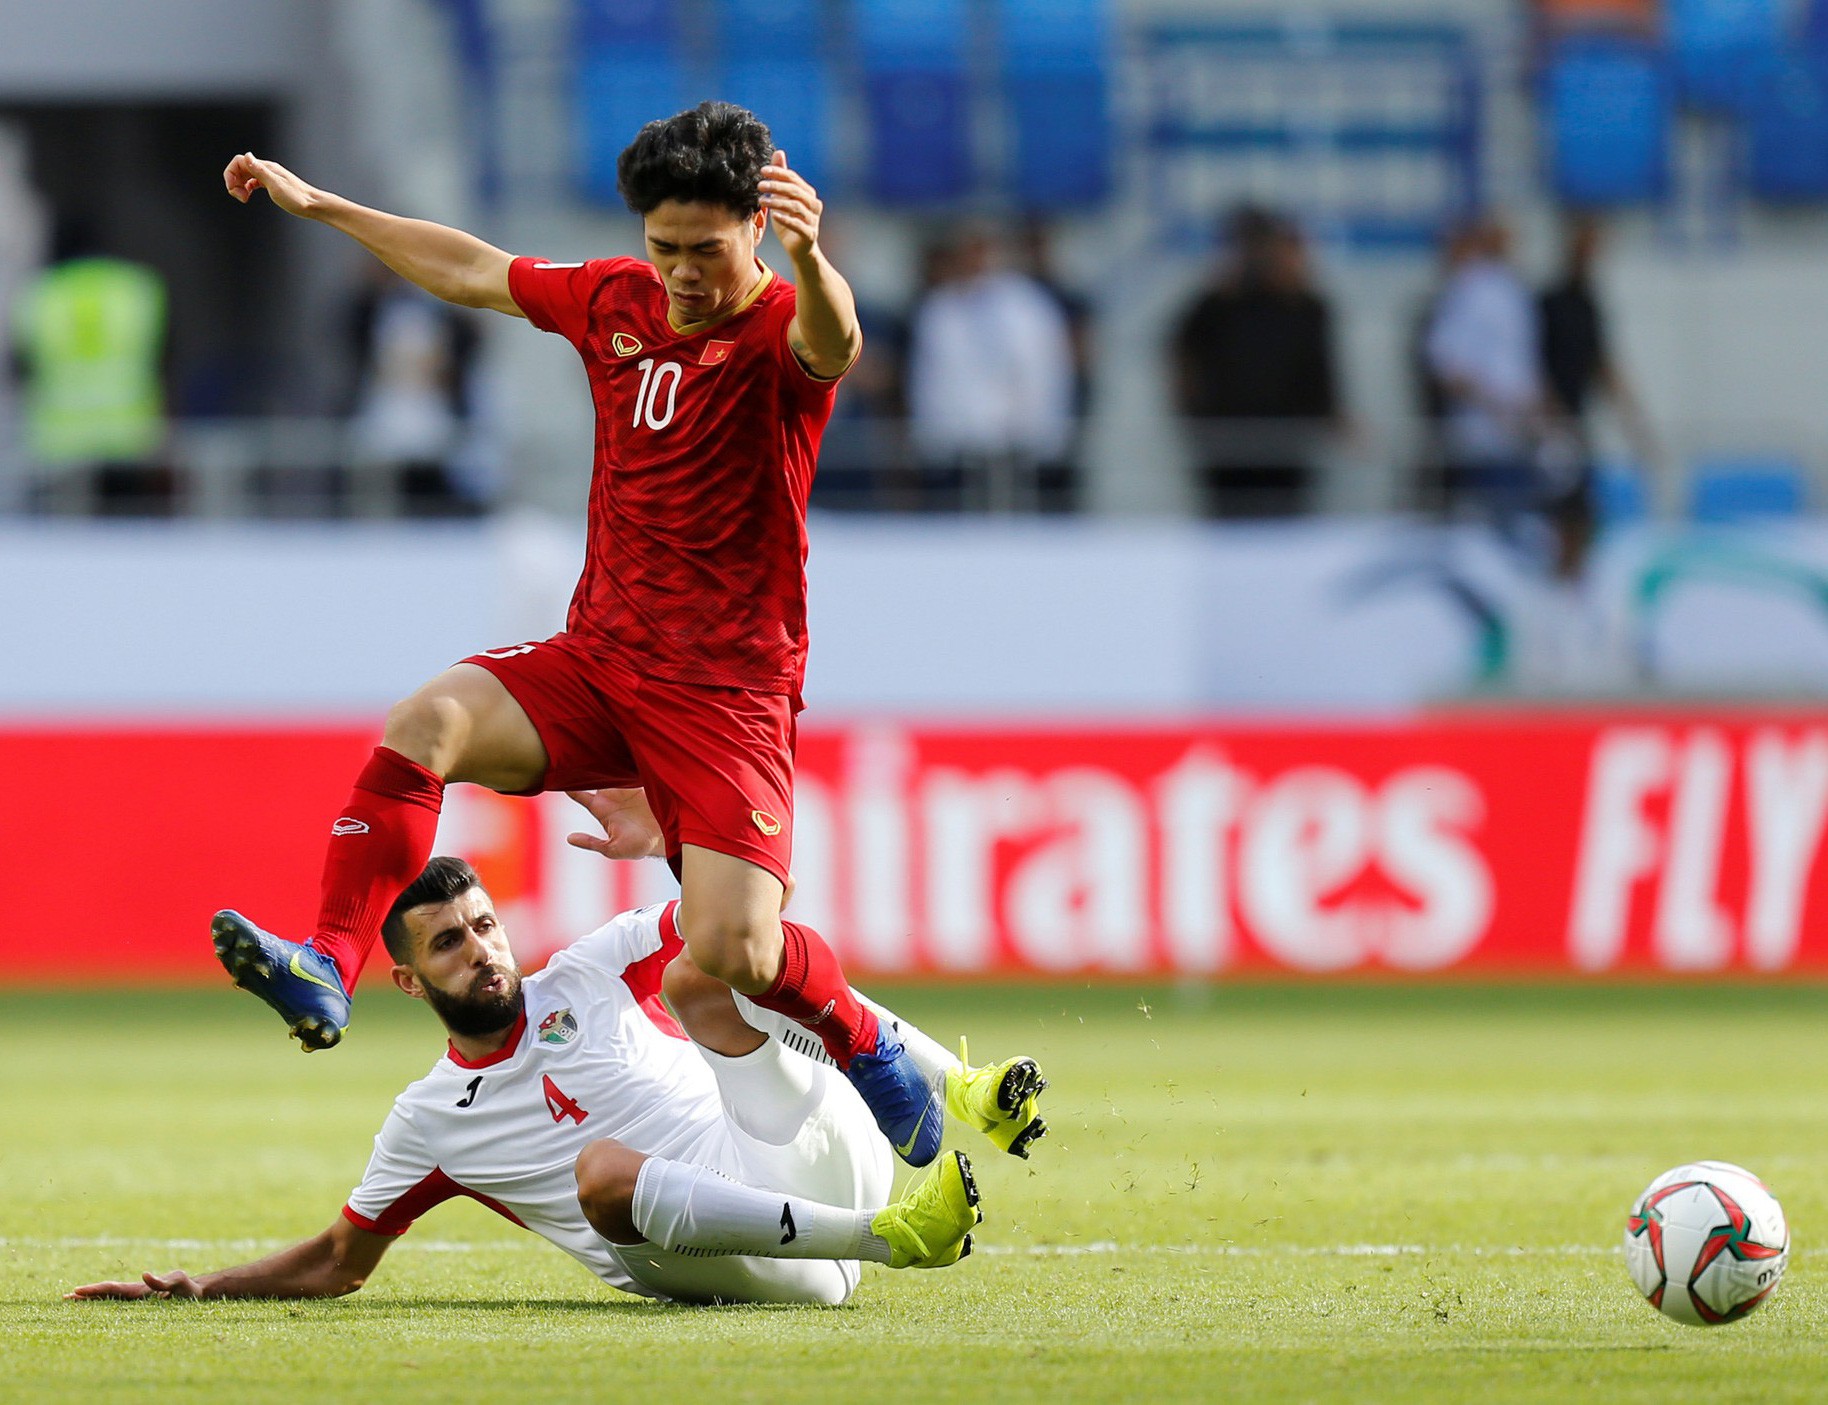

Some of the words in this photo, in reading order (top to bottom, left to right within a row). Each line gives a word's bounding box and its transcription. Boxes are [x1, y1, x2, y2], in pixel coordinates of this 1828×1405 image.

[632, 358, 683, 431] 10
[1566, 725, 1828, 971] FLY
[542, 1073, 590, 1126] 4
